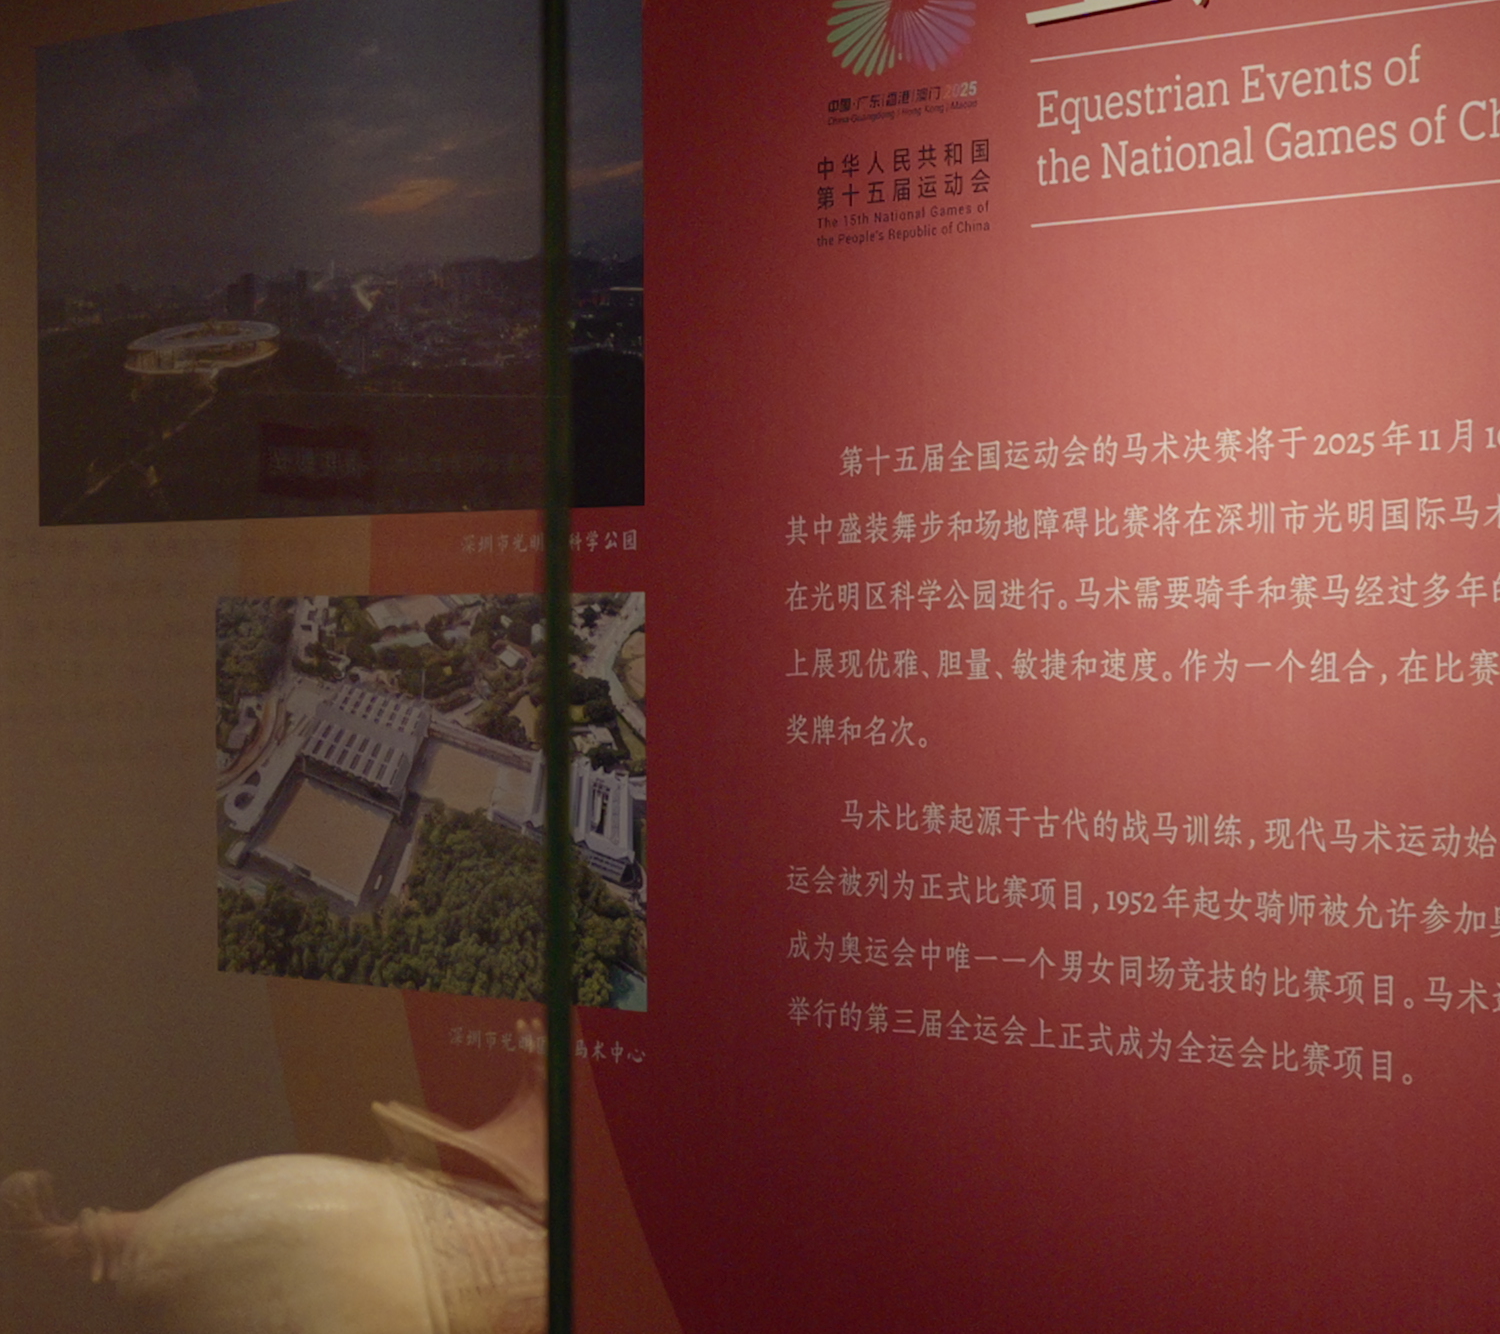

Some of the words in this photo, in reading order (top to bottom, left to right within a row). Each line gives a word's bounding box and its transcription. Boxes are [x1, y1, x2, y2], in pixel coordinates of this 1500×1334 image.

[1036, 73, 1231, 135] Equestrian
[1241, 56, 1373, 105] Events
[1383, 43, 1422, 87] of
[817, 138, 990, 181] 中华人民共和国
[1036, 147, 1091, 187] the
[1101, 125, 1254, 180] National
[1264, 118, 1398, 164] Games
[1408, 103, 1447, 147] of
[816, 167, 991, 211] 第十五届运动会
[816, 233, 835, 248] the
[838, 230, 885, 245] People's
[888, 224, 937, 242] Republic
[941, 221, 954, 235] of
[956, 220, 991, 234] China
[817, 216, 838, 229] The
[843, 210, 870, 228] 15th
[874, 207, 926, 224] National
[930, 204, 972, 218] Games
[977, 200, 990, 213] of
[461, 527, 638, 555] 深圳市光明科学公园
[786, 713, 929, 750] 奖牌和名次。
[450, 1026, 646, 1065] 深圳市光明国马术中心
[786, 994, 1415, 1087] 举行的第三届全运会上正式成为全运会比赛项目。
